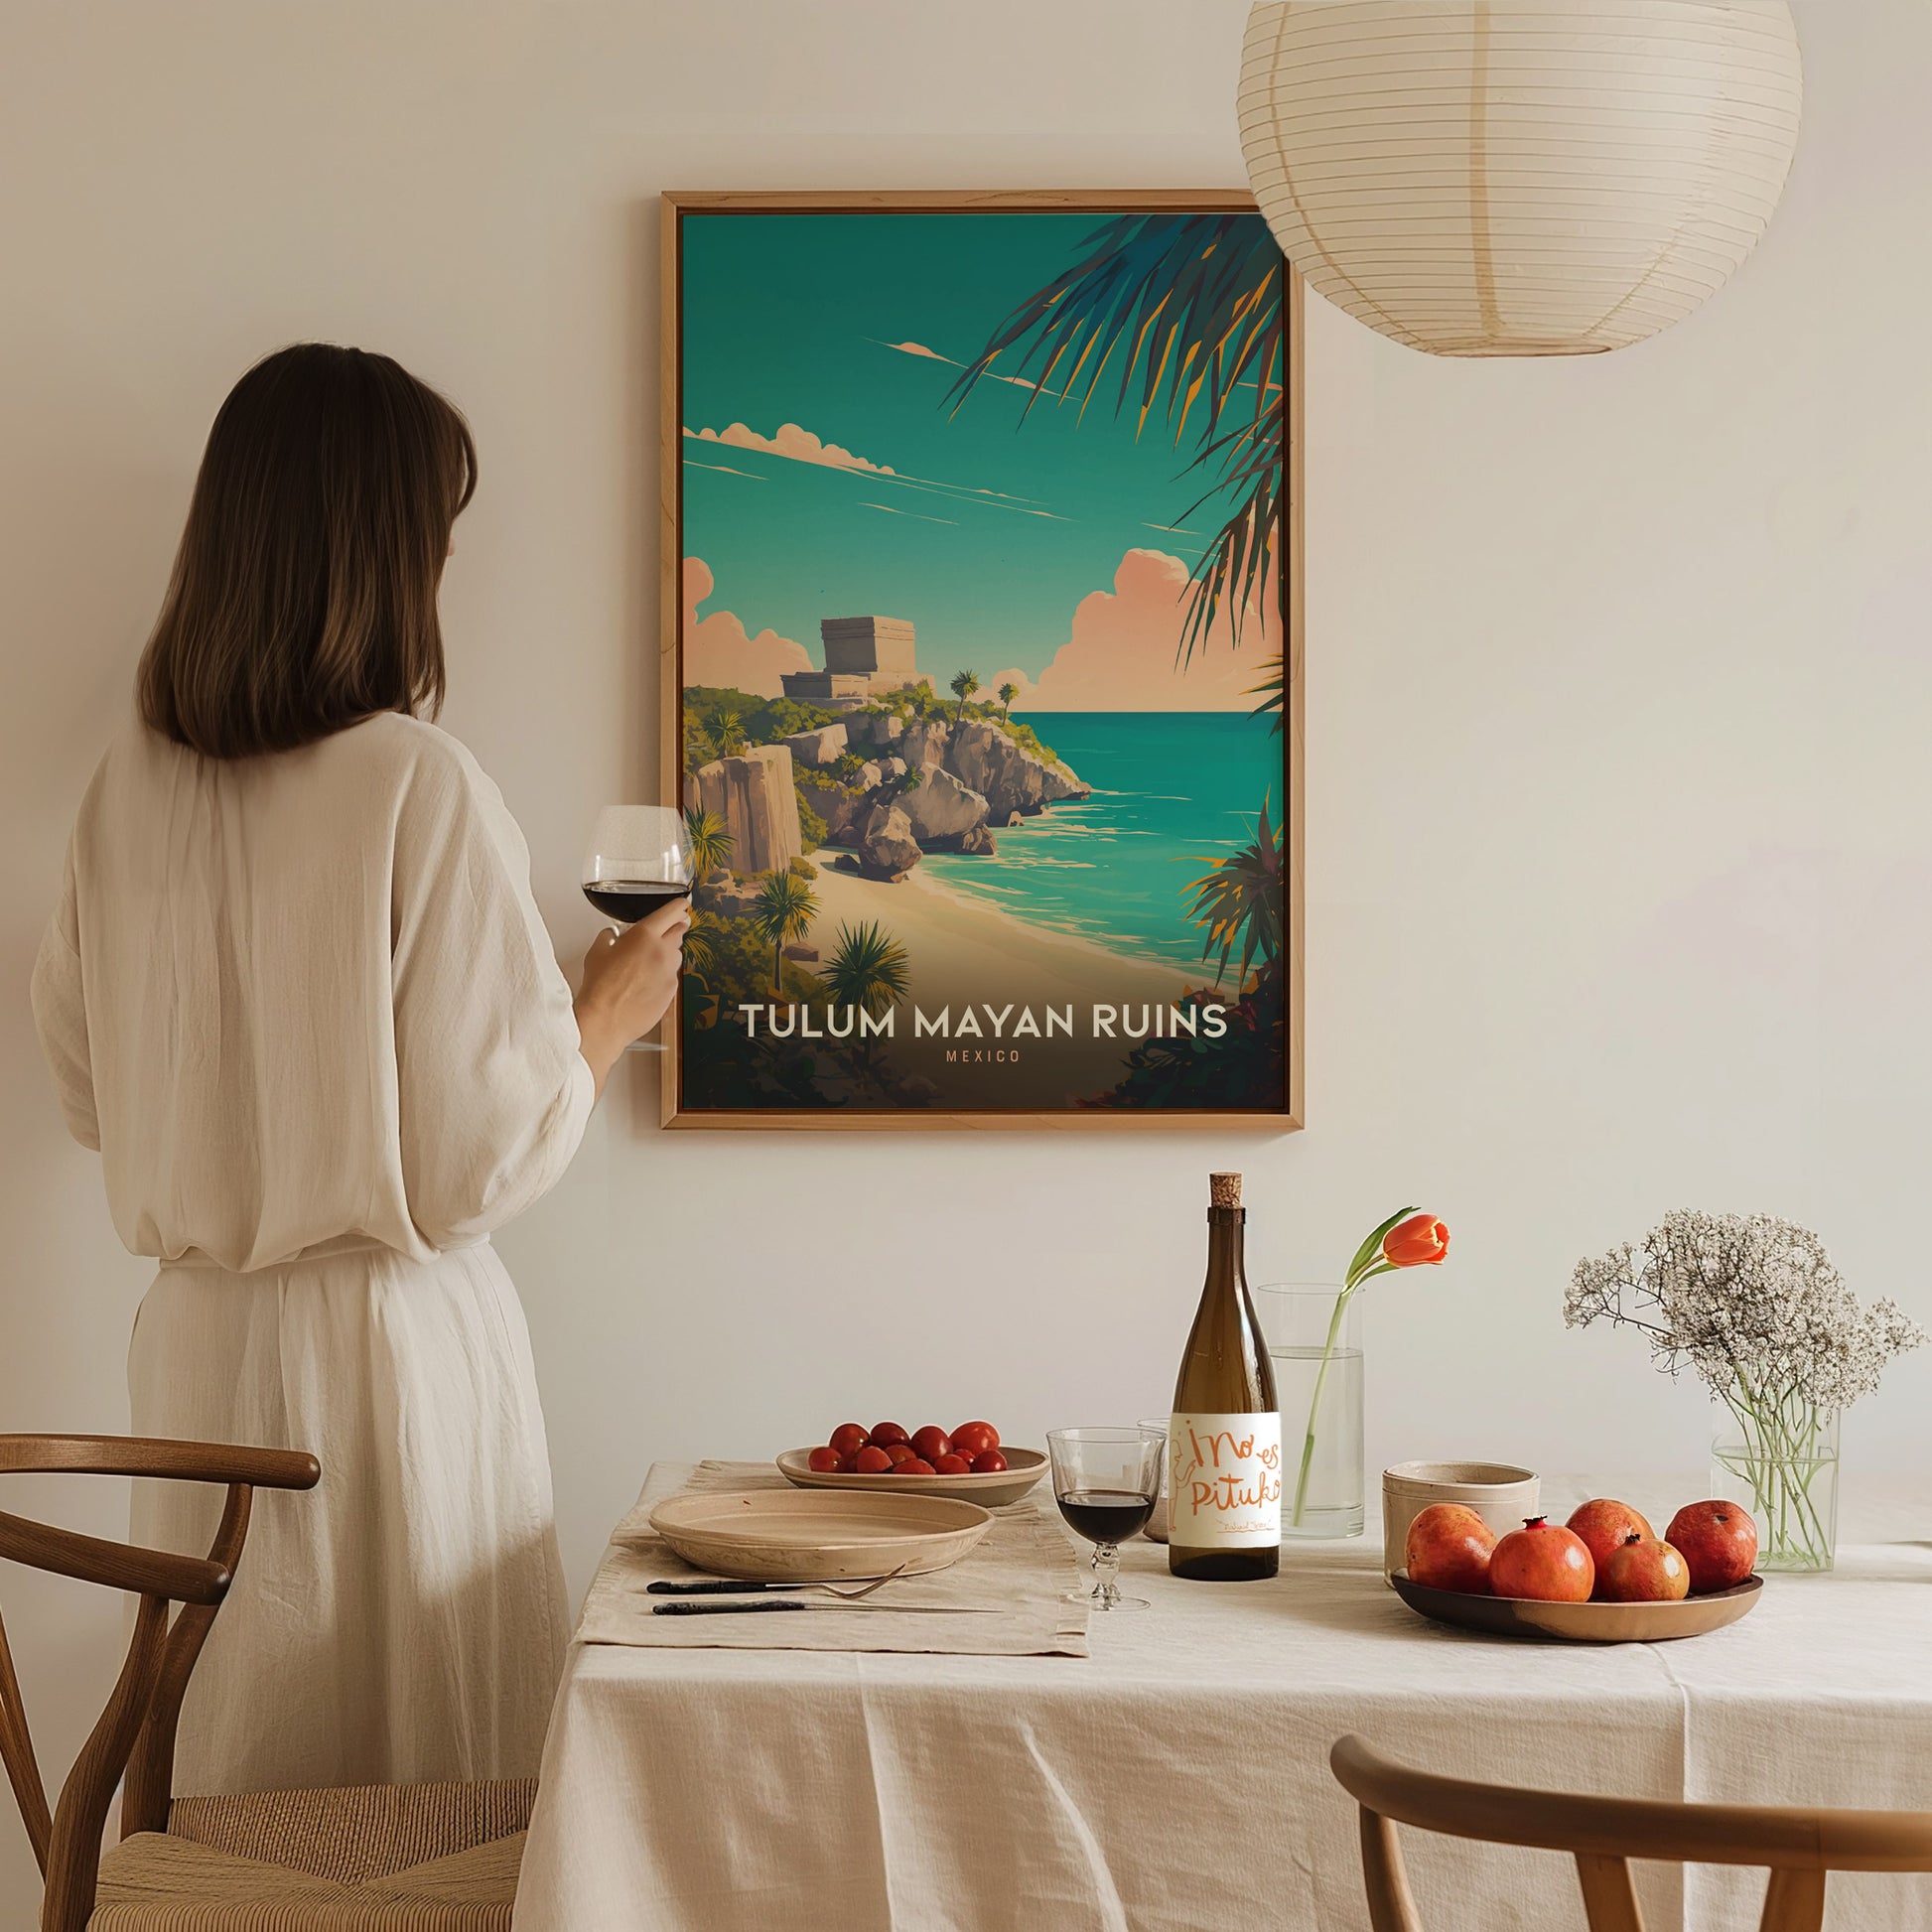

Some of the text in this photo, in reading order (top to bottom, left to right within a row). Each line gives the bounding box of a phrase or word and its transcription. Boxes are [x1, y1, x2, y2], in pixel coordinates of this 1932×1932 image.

[738, 1003, 1227, 1038] TULUM MAYAN RUINS
[946, 1049, 1020, 1062] MEXICO
[1256, 1444, 1279, 1469] es
